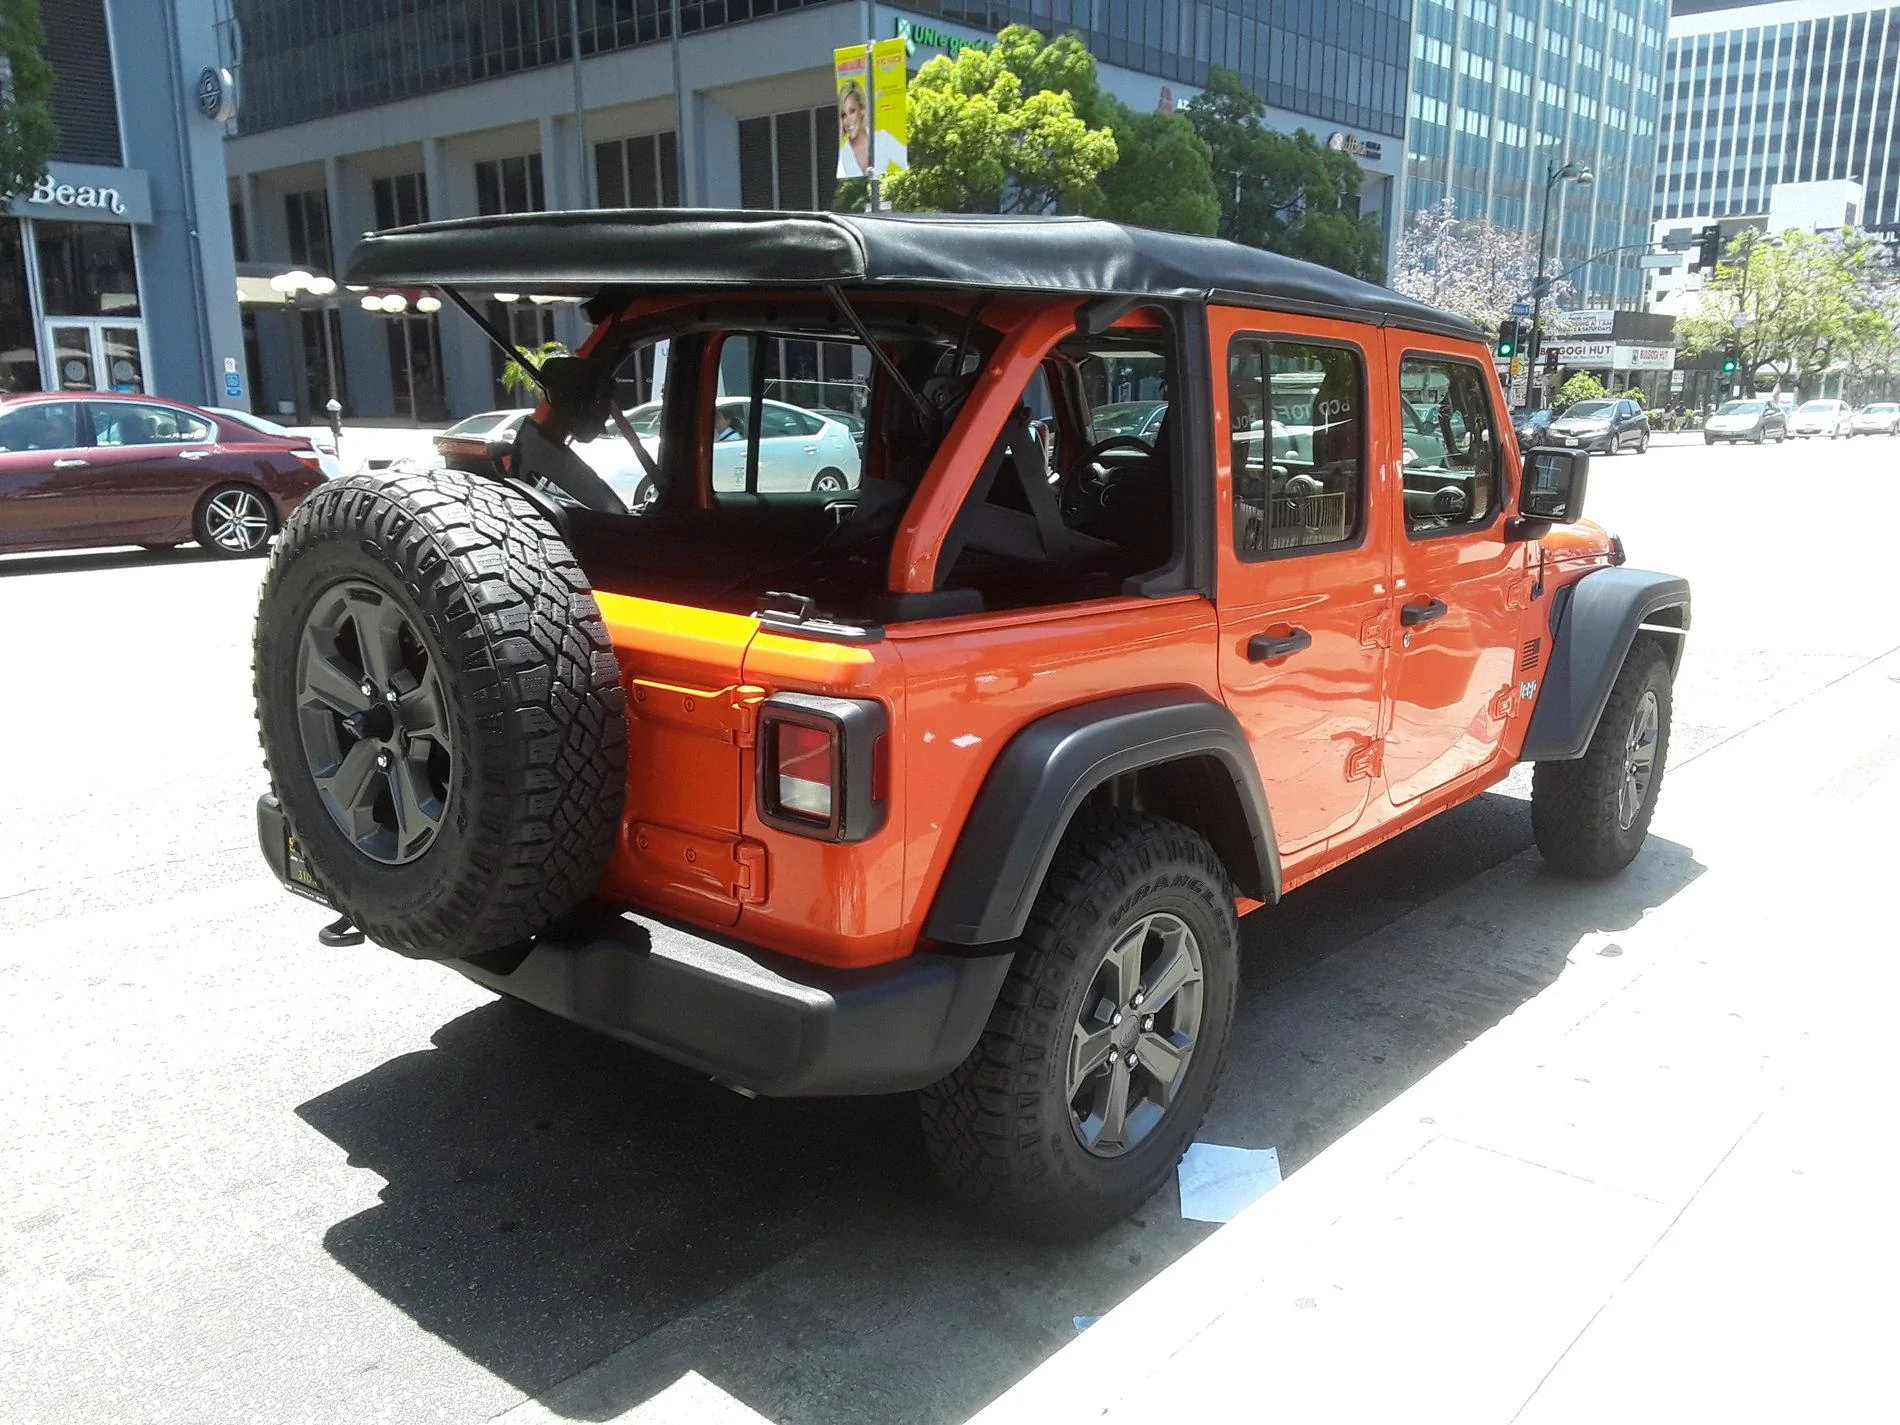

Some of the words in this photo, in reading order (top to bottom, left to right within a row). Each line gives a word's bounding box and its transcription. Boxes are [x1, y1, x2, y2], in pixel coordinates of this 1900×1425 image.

[28, 174, 126, 215] Bean
[1540, 346, 1586, 356] BGOGI
[1588, 345, 1612, 355] HUT
